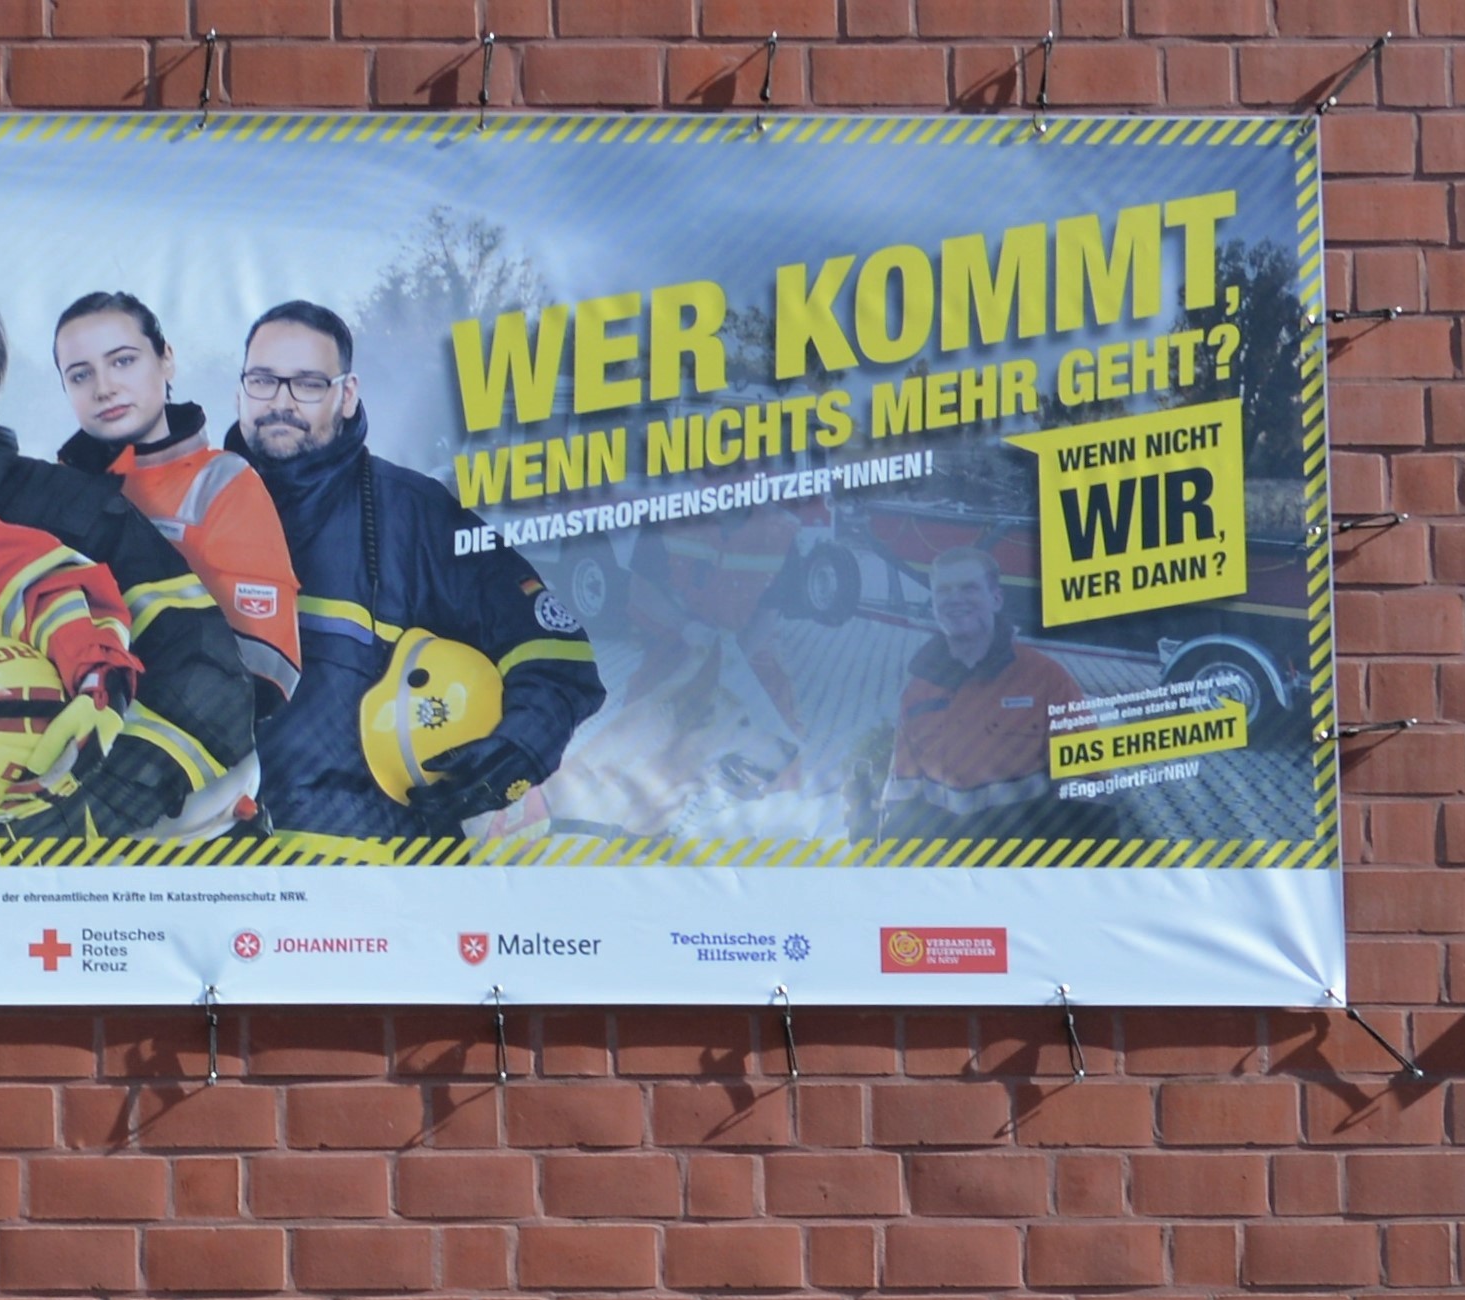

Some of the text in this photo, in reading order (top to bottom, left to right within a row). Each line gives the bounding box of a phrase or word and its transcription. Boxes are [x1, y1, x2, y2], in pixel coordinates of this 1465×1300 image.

[451, 190, 1240, 431] WER KOMMT,
[454, 323, 1241, 508] WENN NICHTS MEHR GEHT?
[1057, 422, 1223, 473] WENN NICHT
[1059, 467, 1226, 563] WIR,
[454, 518, 496, 555] DIE
[1061, 569, 1121, 602] WER
[1047, 704, 1066, 716] Der
[1068, 688, 1169, 714] Katastrophenschutz
[1170, 681, 1195, 695] NRW
[1197, 677, 1213, 691] hat
[1049, 712, 1098, 731] Aufgaben
[1099, 708, 1119, 722] und
[1121, 705, 1143, 719] eine
[1145, 699, 1178, 715] starke
[1059, 717, 1237, 767] DAS EHRENAMT
[1059, 761, 1200, 800] #EngagiertFürNRW
[2, 892, 19, 902] der
[23, 892, 109, 903] ehrenamtlichen
[112, 891, 146, 902] Kräfte
[168, 891, 276, 904] Katastrophenschutz
[280, 891, 308, 901] NRW.
[82, 928, 166, 941] Deutsches
[82, 944, 128, 957] Rotes
[273, 937, 389, 953] JOHANNITER
[497, 932, 602, 956] Malteser
[670, 931, 776, 946] Technisches
[82, 959, 128, 972] Kreuz
[697, 948, 777, 962] Hilfswerk
